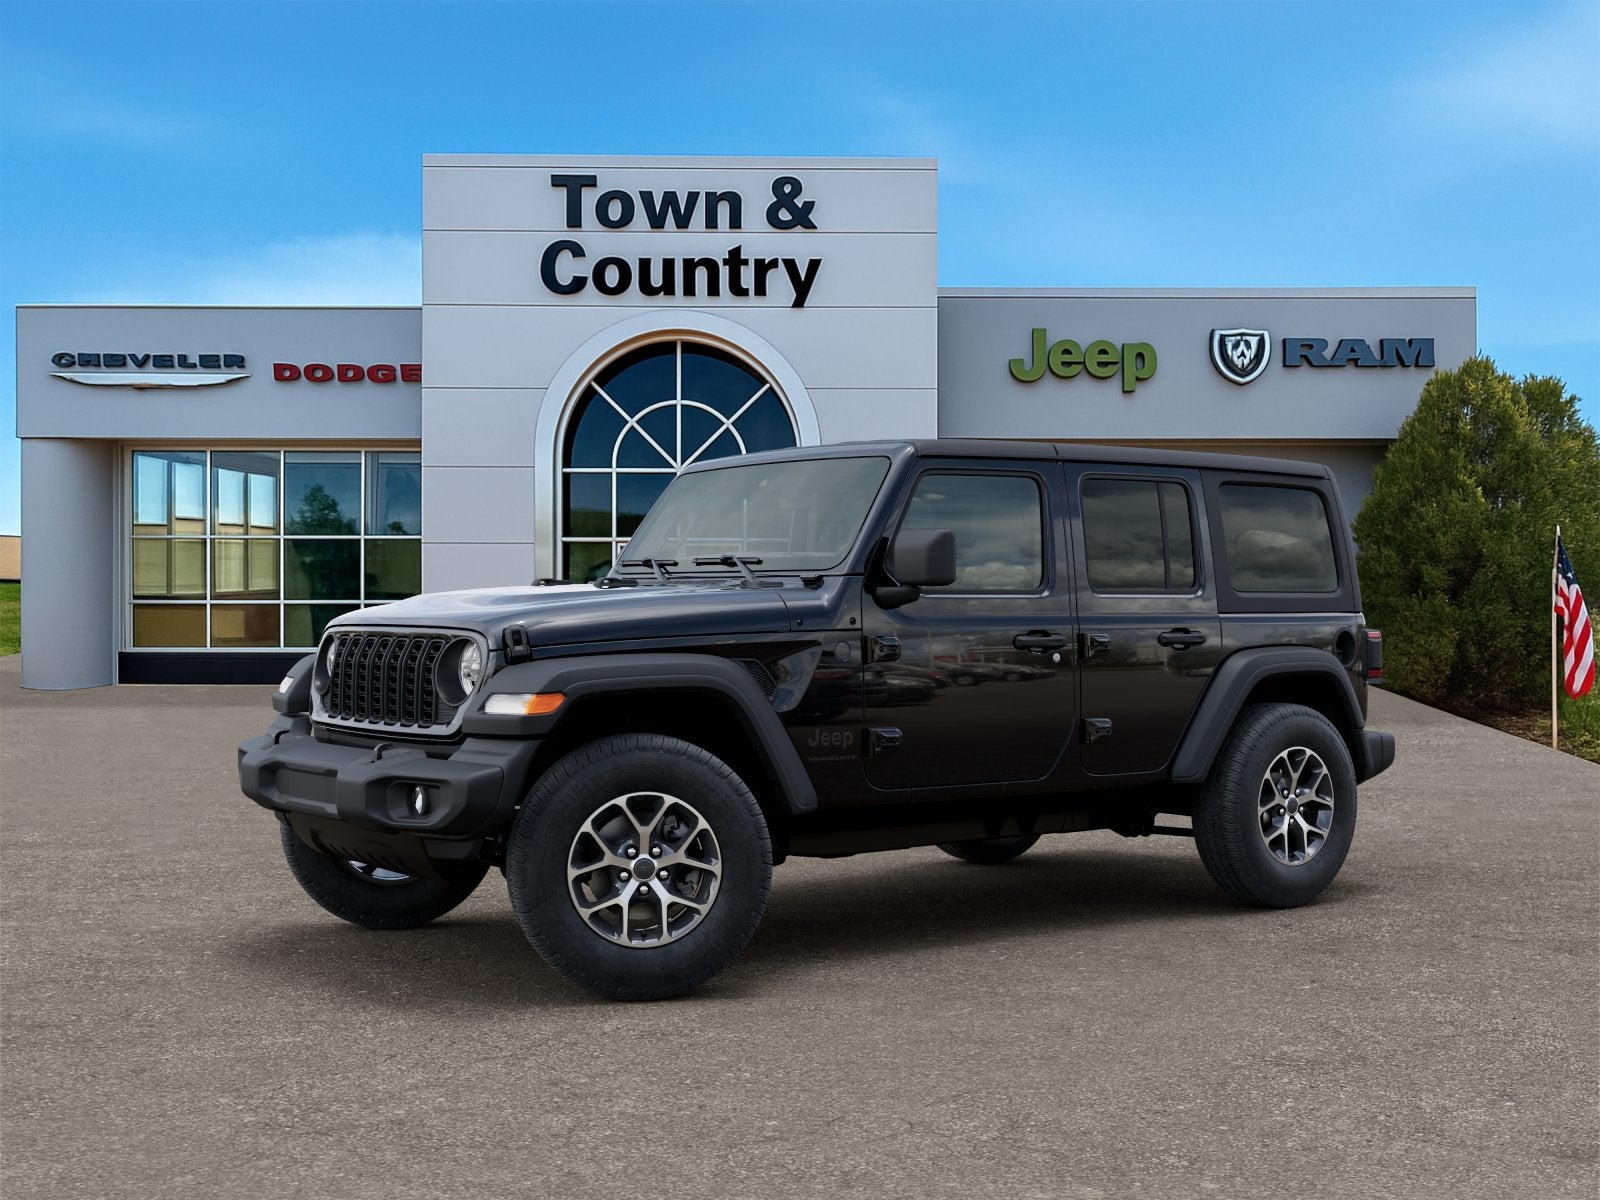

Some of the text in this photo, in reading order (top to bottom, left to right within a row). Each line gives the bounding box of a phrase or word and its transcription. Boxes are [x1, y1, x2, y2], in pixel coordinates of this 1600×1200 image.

[550, 174, 818, 230] Town &
[540, 239, 822, 308] Country
[273, 363, 422, 383] DODGE
[1008, 328, 1157, 393] Jeep
[1283, 338, 1435, 369] RAM
[808, 729, 853, 749] Jeep
